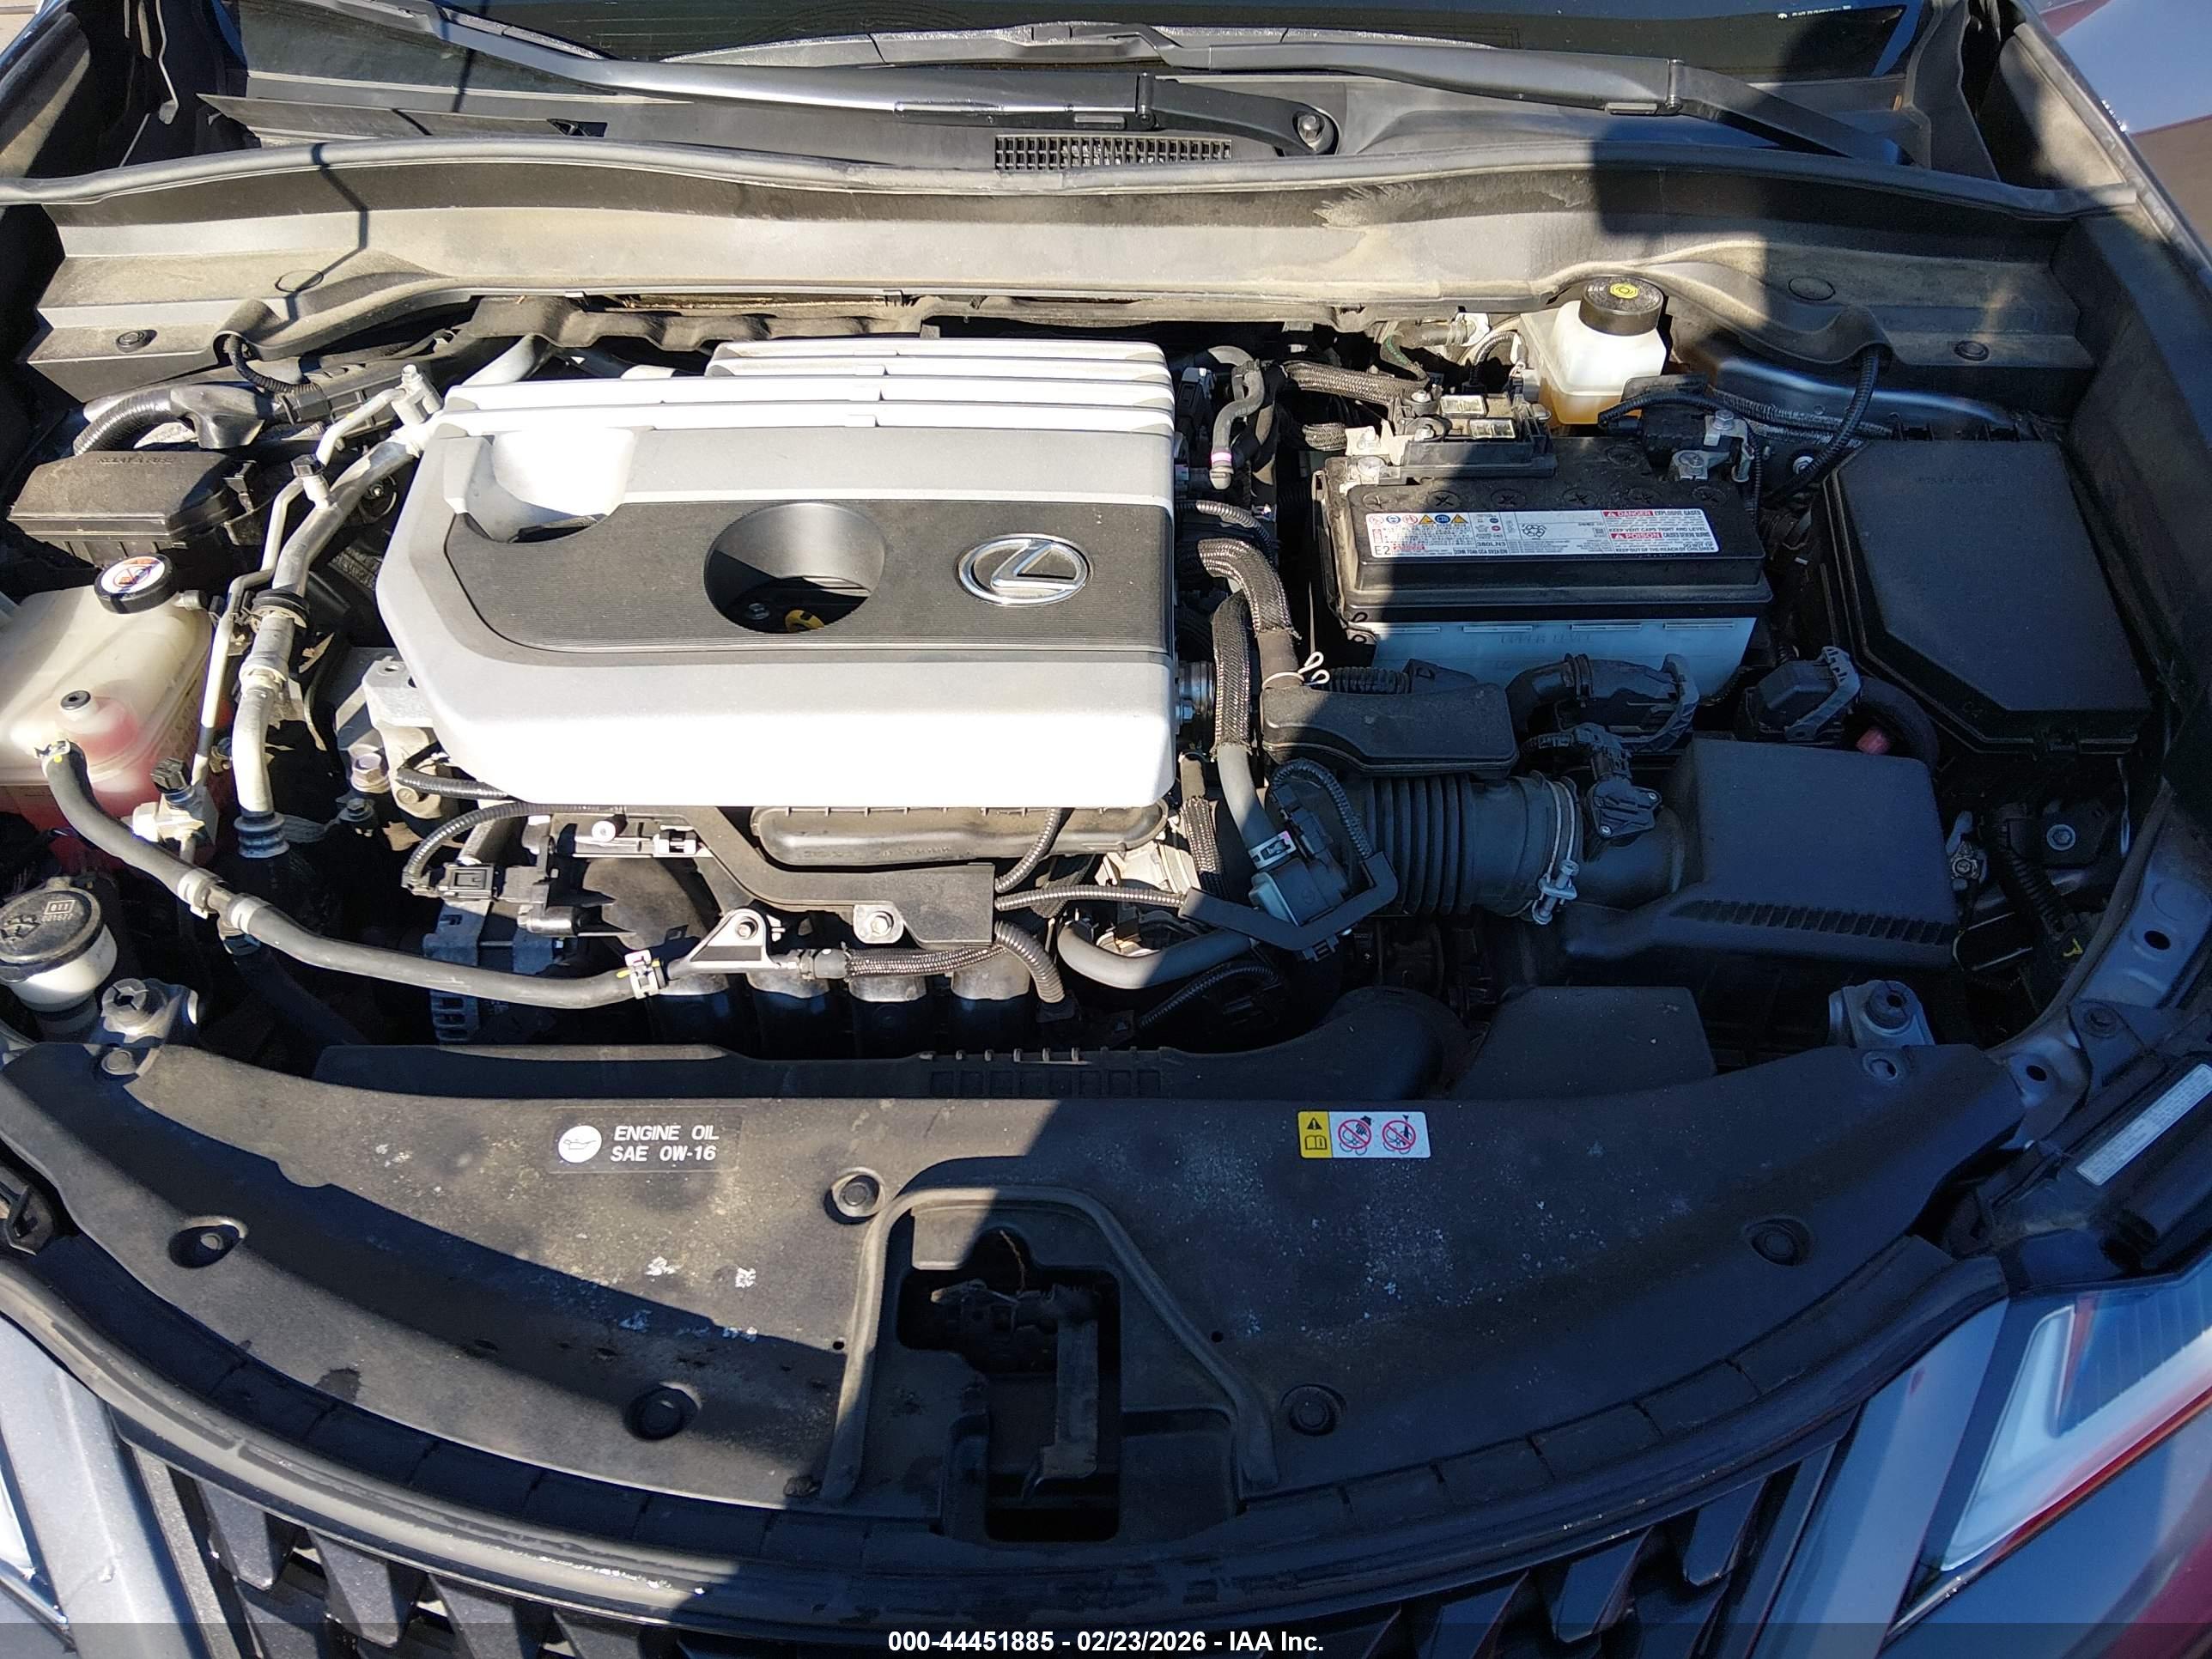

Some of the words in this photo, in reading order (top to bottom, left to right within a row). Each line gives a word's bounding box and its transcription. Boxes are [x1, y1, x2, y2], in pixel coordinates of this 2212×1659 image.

[1374, 545, 1391, 556] E2
[613, 1125, 682, 1141] ENGINE
[691, 1125, 720, 1140] OIL
[610, 1146, 649, 1162] SAE
